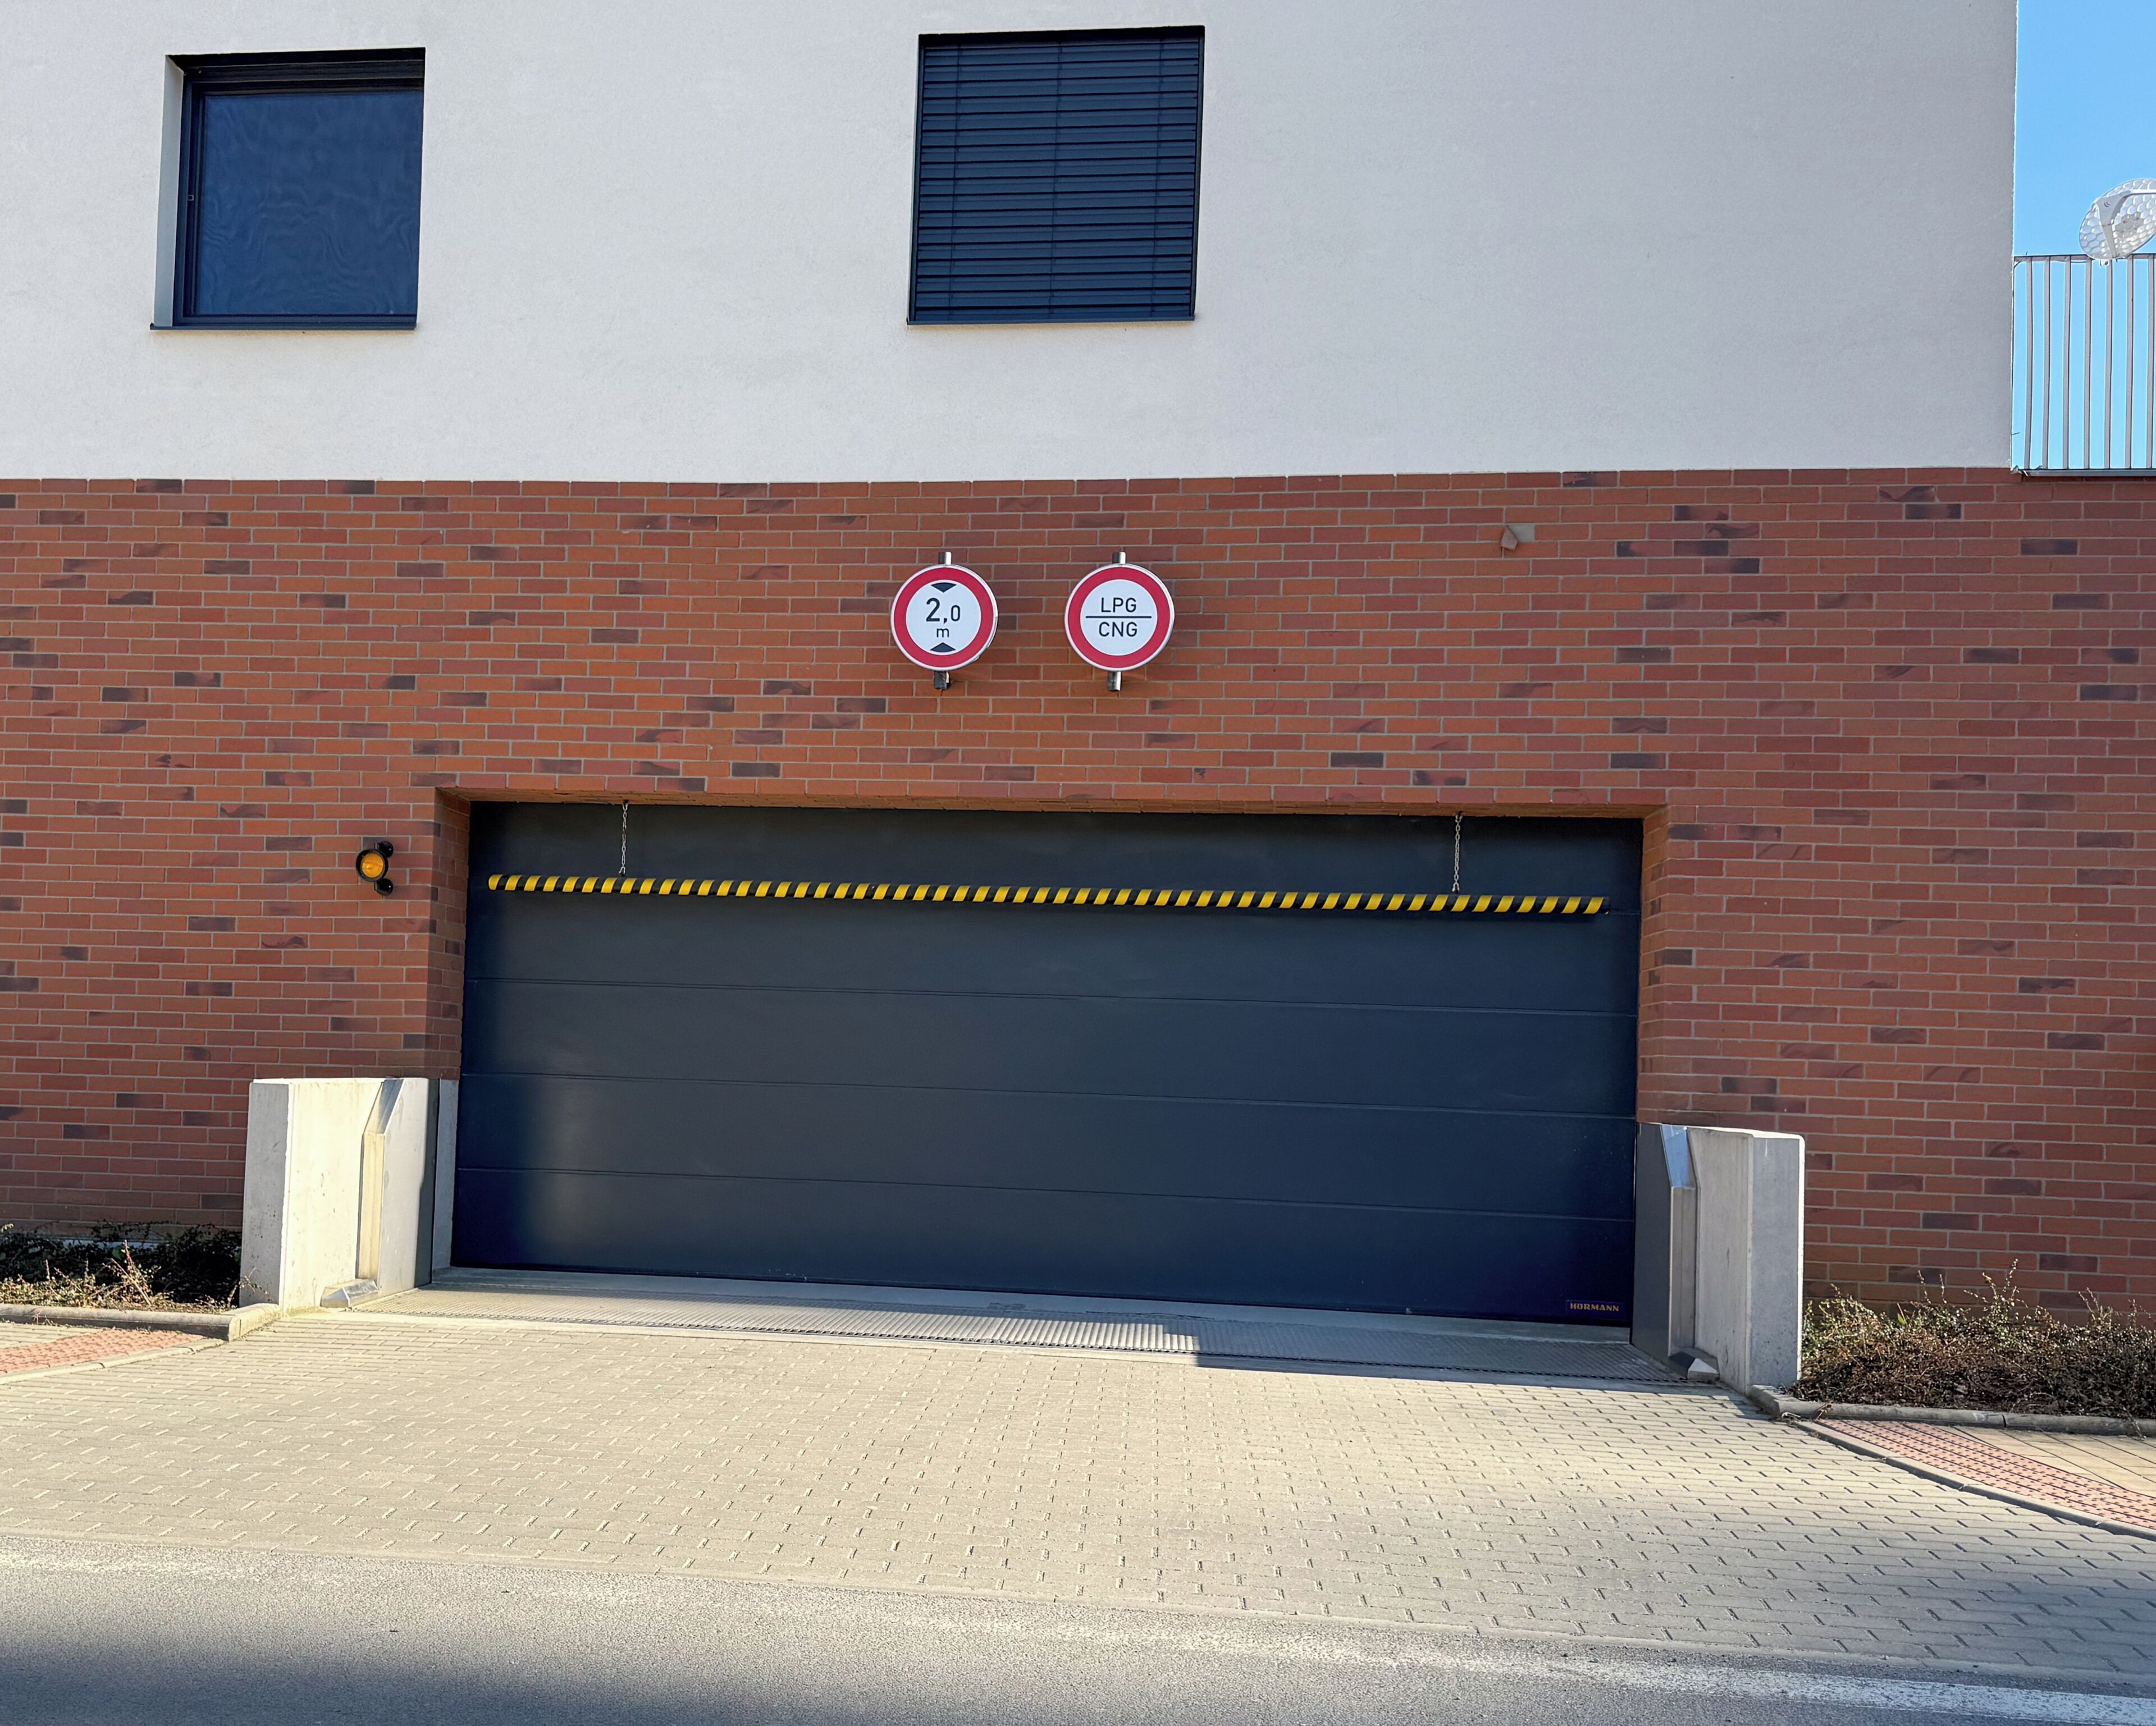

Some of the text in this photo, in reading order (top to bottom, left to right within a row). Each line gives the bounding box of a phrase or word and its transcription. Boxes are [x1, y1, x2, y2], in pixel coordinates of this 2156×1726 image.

[926, 597, 961, 624] 2,0
[1101, 597, 1136, 613] LPG
[936, 628, 949, 638] m
[1099, 621, 1138, 637] CNG
